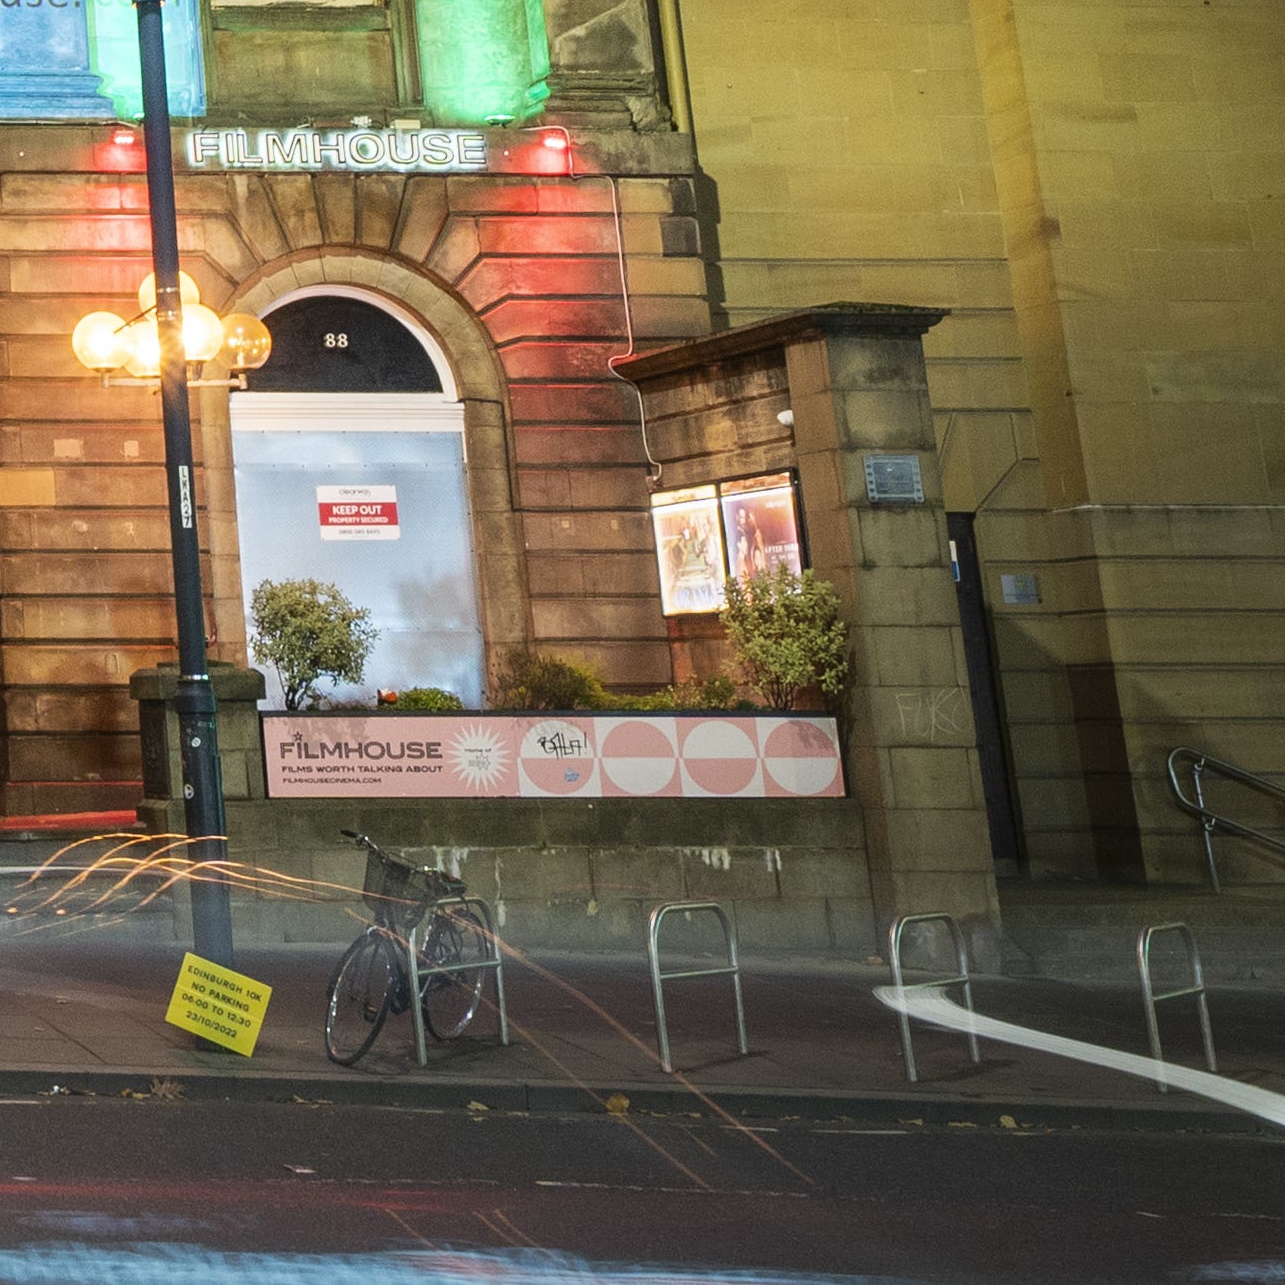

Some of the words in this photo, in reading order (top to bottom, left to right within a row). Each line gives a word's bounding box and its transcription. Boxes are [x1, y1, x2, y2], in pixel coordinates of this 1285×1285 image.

[191, 131, 487, 165] FILMHOUSE
[323, 333, 349, 348] 88
[332, 505, 359, 515] KEEP
[359, 505, 383, 515] OUT
[279, 739, 444, 760] FILMHOUSE
[281, 765, 314, 774] FILMS
[315, 765, 356, 774] WORTH
[357, 765, 403, 774] TALKING
[406, 765, 443, 774] ABOUT
[187, 965, 243, 994] EDINBURGH
[246, 989, 262, 1002] 10K
[191, 981, 206, 993] NO
[209, 989, 250, 1012] PARKING
[212, 1005, 224, 1016] TO
